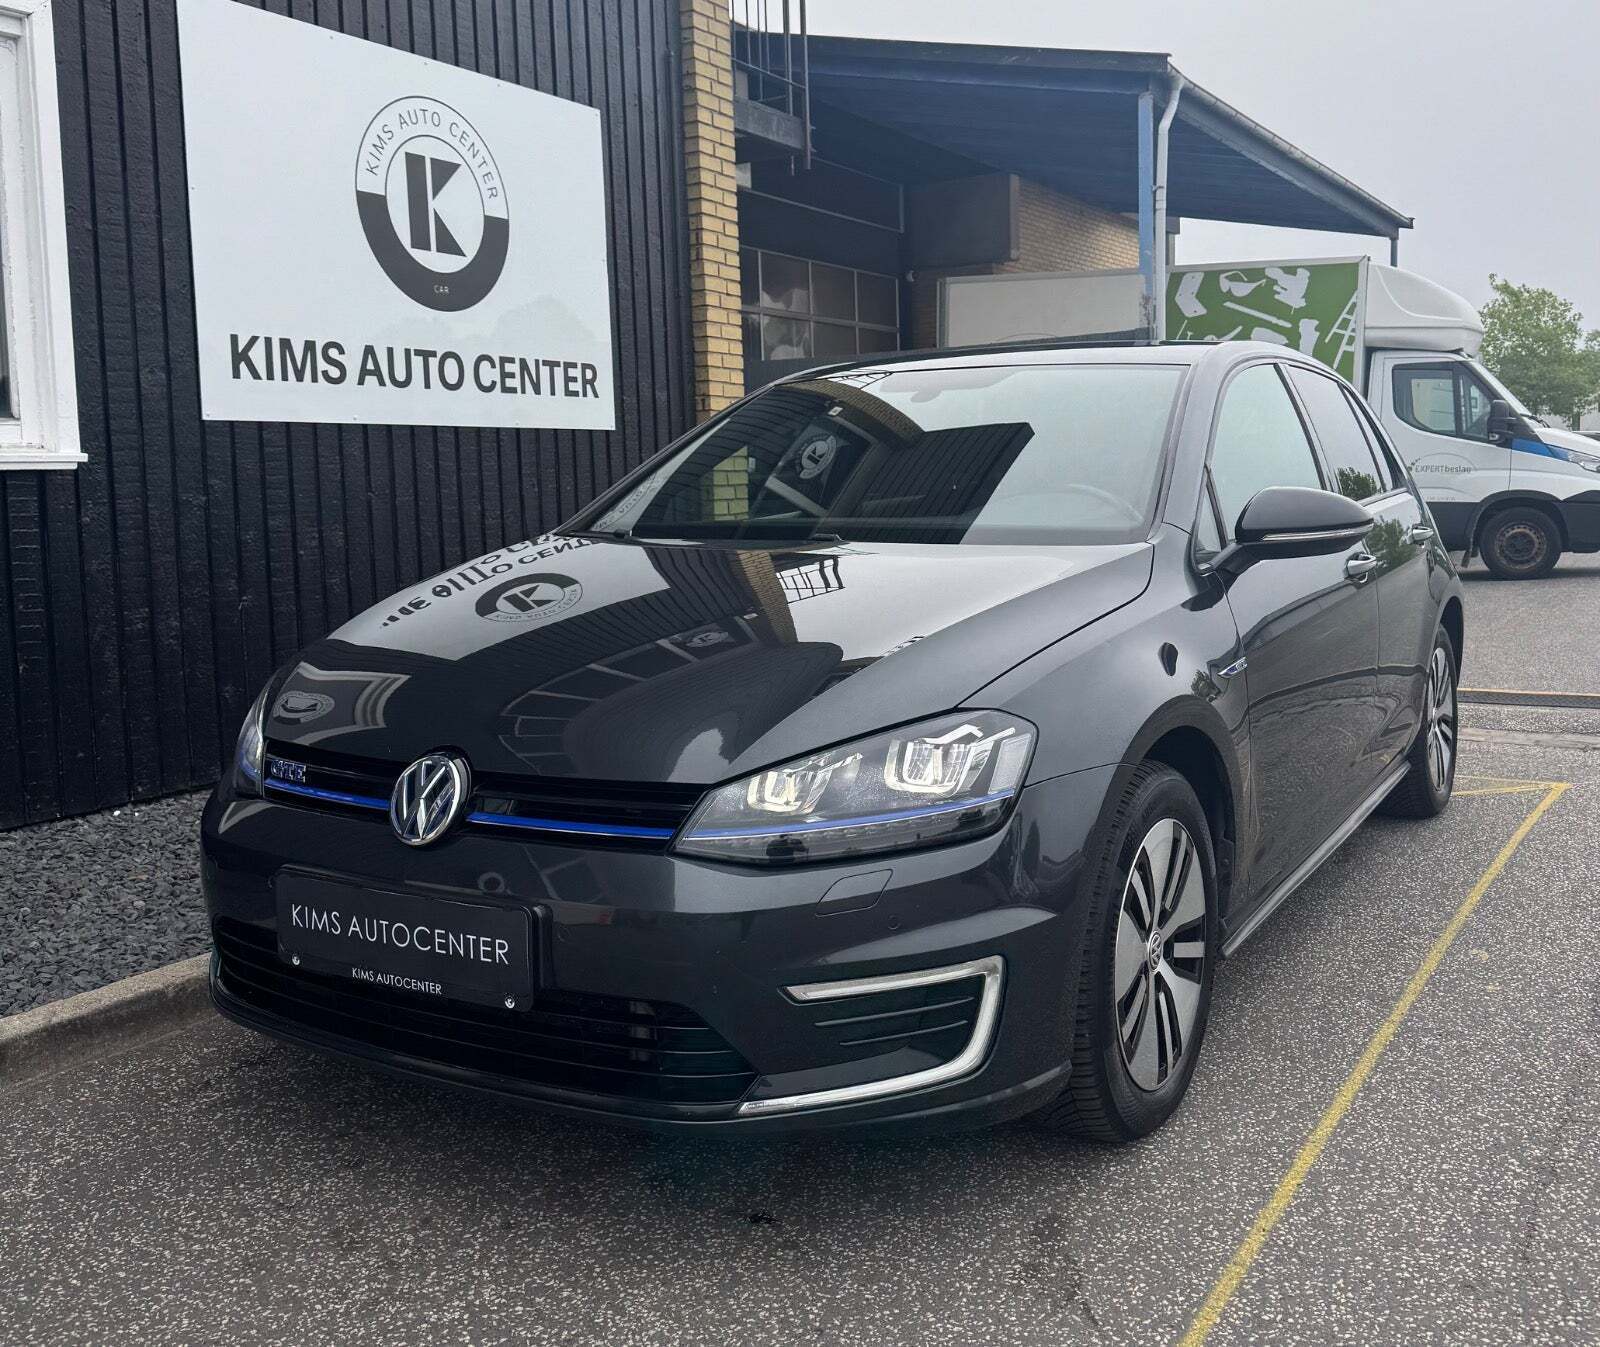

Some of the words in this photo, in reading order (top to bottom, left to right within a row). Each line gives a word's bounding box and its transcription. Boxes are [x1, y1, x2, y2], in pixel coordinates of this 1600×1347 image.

[365, 123, 394, 176] KIMS
[398, 108, 441, 130] AUTO
[449, 122, 498, 200] CENTER
[229, 333, 347, 386] KIMS
[357, 344, 465, 393] AUTO
[473, 354, 600, 399] CENTER
[291, 904, 342, 936] KIMS
[347, 914, 510, 965] AUTOCENTER
[352, 967, 375, 982] KIMS
[376, 973, 443, 996] AUTOCENTER
